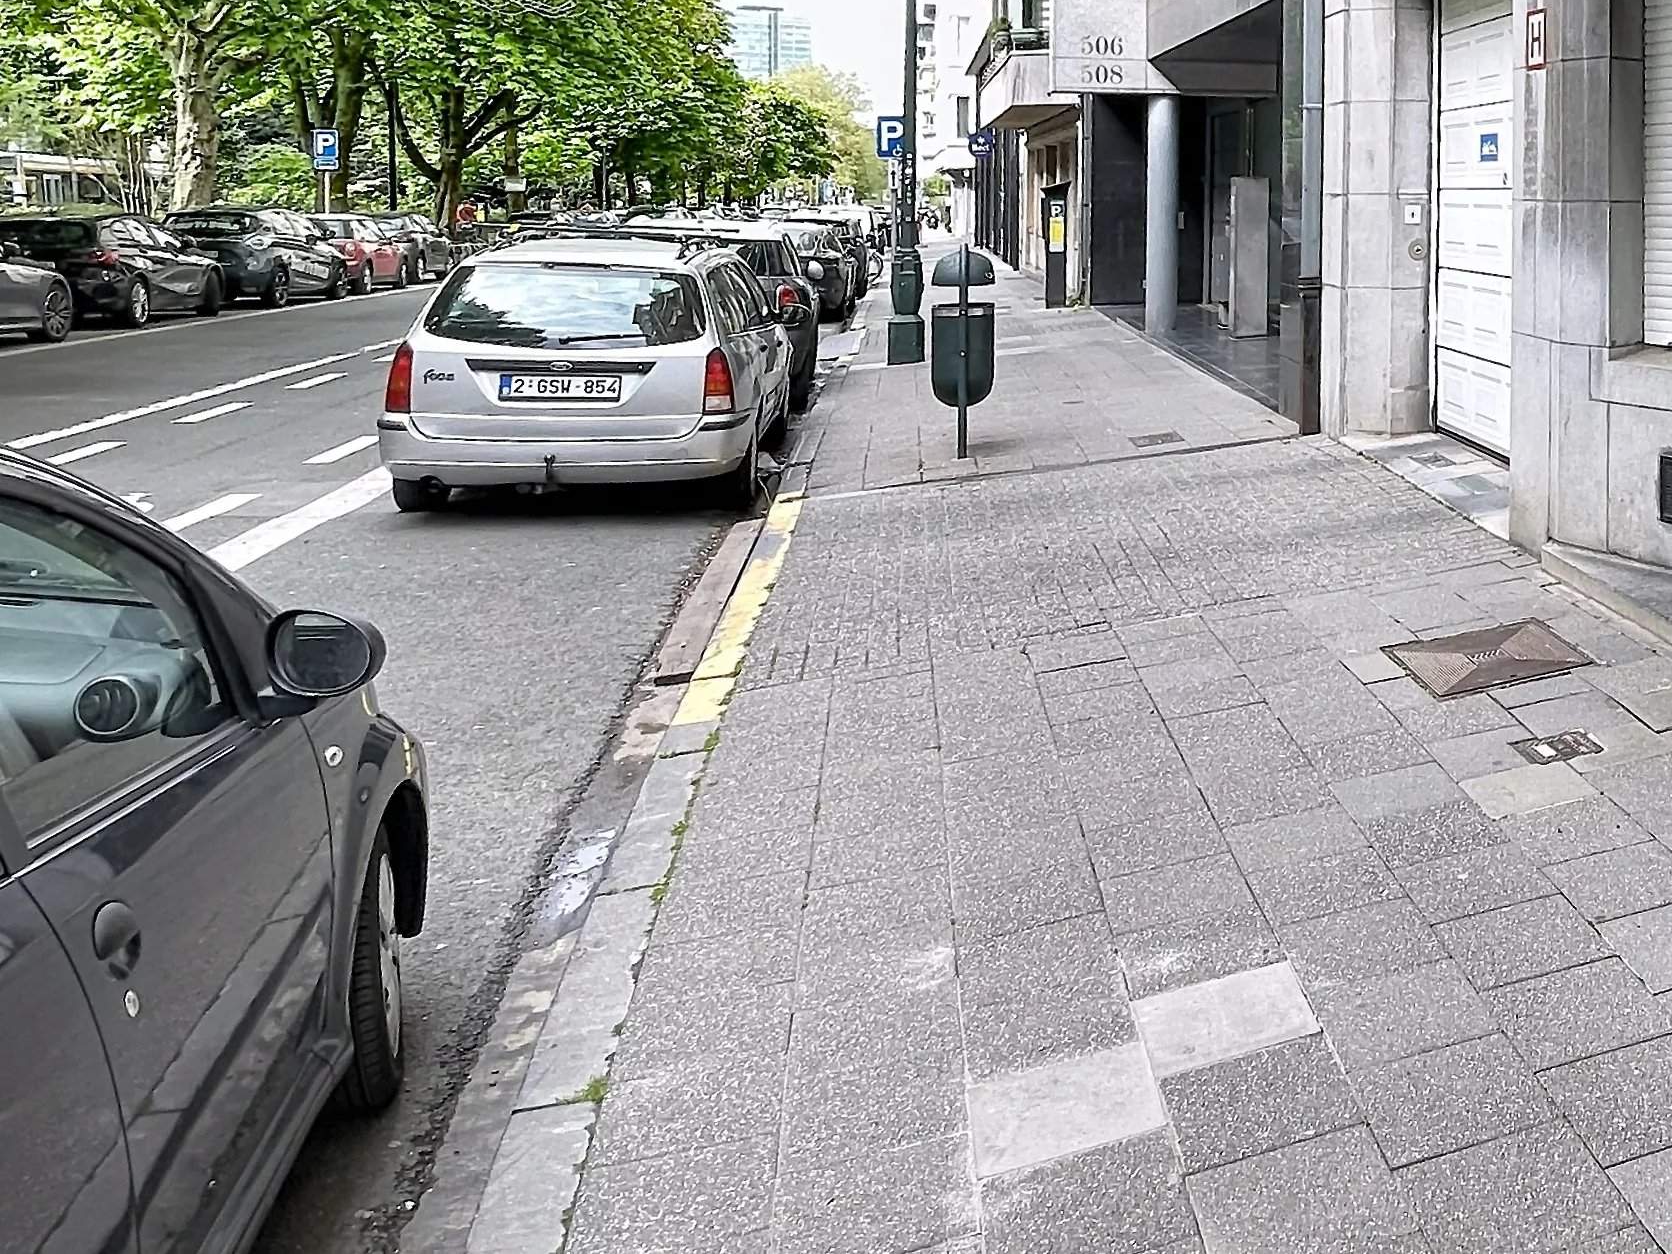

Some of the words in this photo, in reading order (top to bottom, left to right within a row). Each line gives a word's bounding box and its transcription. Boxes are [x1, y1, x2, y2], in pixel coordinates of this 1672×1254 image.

[1080, 35, 1124, 56] 506
[1530, 20, 1542, 59] H
[1080, 64, 1124, 85] 508
[316, 133, 335, 155] P
[880, 120, 904, 152] P
[1050, 205, 1062, 218] P
